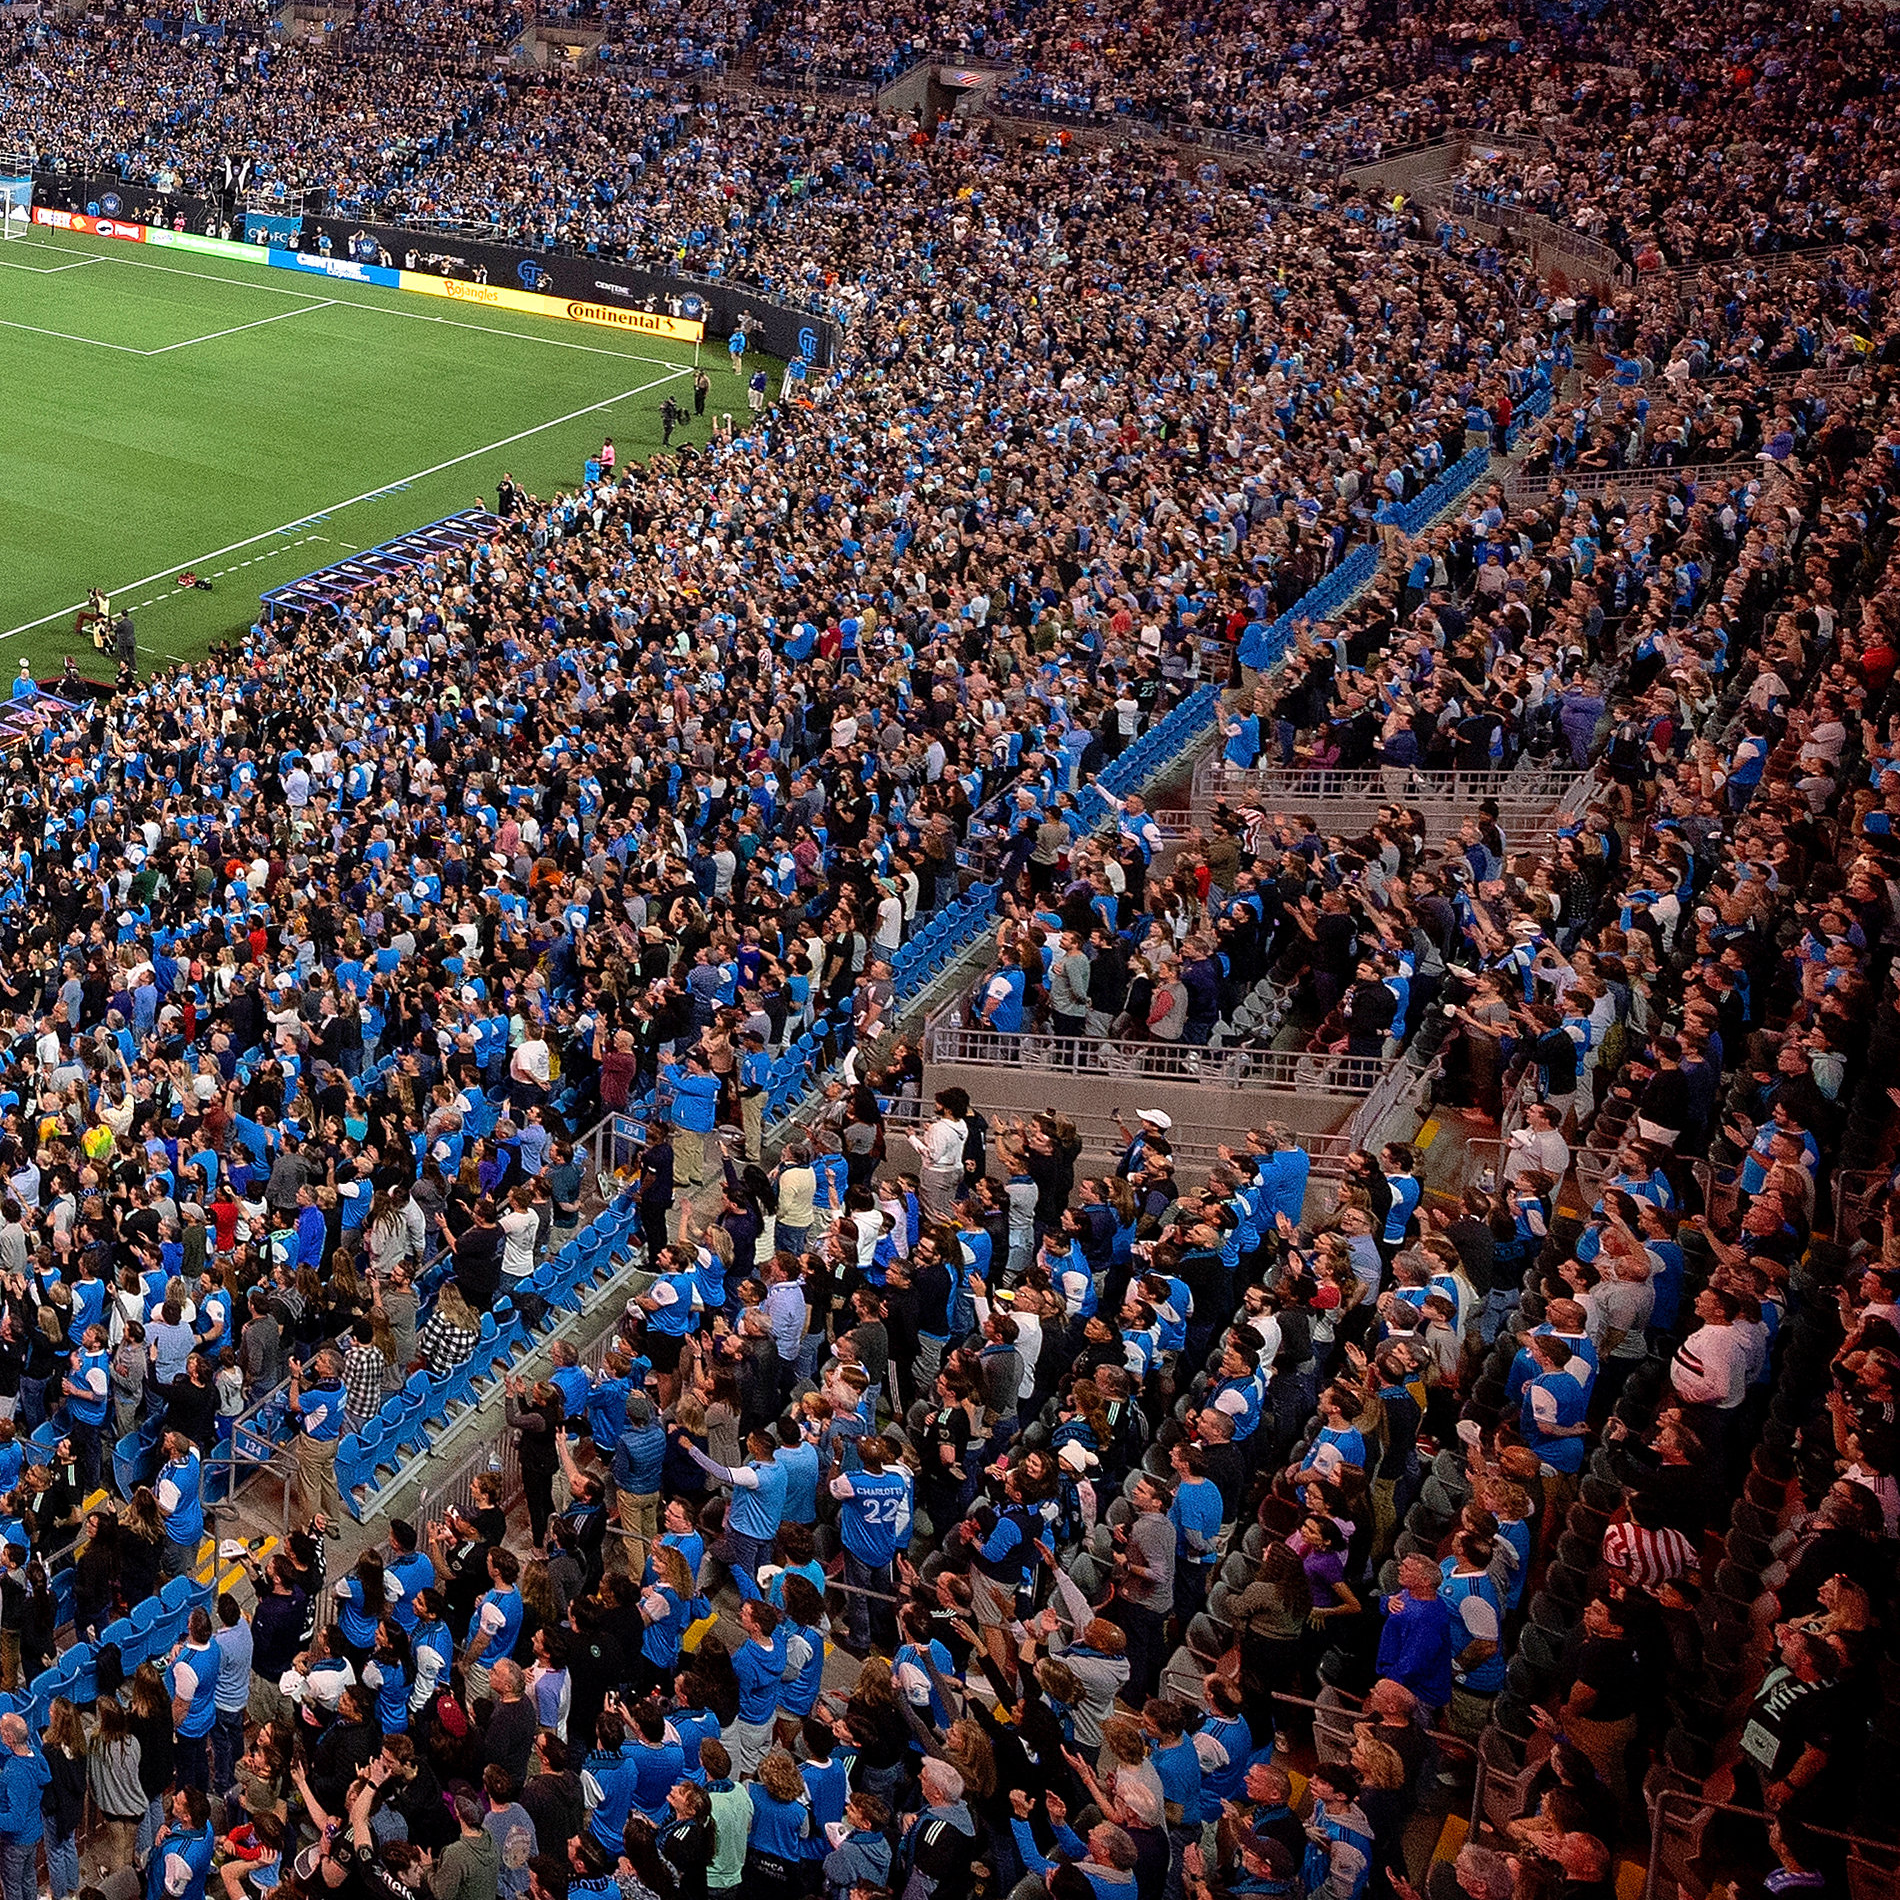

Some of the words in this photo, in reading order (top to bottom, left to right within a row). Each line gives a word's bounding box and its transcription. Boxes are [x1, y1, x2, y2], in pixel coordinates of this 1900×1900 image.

[443, 280, 499, 301] Bojangles
[567, 301, 660, 330] Continental
[623, 1123, 640, 1137] 134
[244, 1439, 262, 1456] 134
[856, 1485, 904, 1496] CHARLOTTE
[863, 1498, 900, 1524] 22
